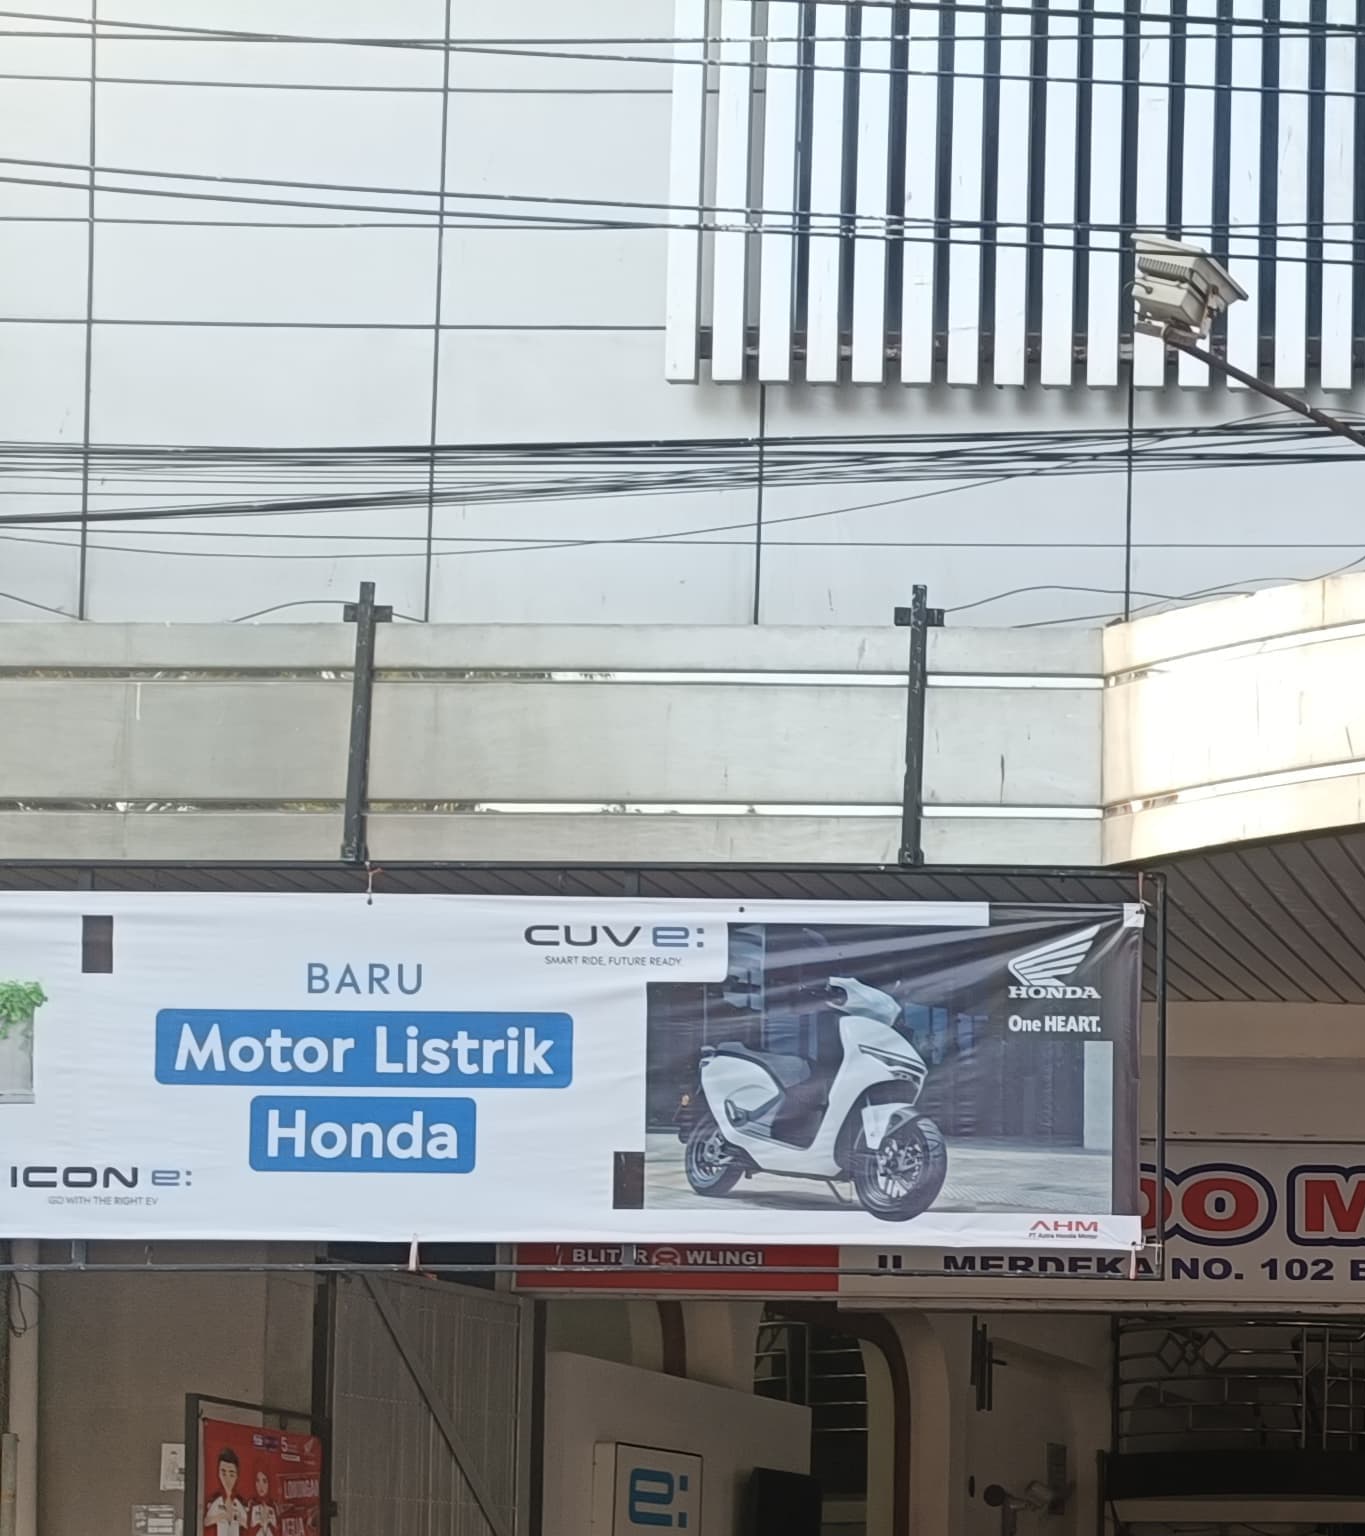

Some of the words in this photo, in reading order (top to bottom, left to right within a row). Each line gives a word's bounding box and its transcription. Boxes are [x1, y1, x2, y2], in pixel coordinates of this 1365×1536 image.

[524, 924, 642, 948] CUV
[652, 926, 705, 948] e:
[544, 955, 579, 966] SMART
[608, 956, 648, 967] FUTURE
[307, 962, 424, 995] BARU
[1007, 985, 1102, 1000] HONDA
[1007, 1014, 1042, 1033] One
[1044, 1015, 1102, 1033] HEART.
[174, 1022, 355, 1074] Motor
[375, 1024, 556, 1076] Listrik
[266, 1108, 459, 1160] Honda
[10, 1165, 139, 1189] ICON
[151, 1169, 193, 1187] e:
[66, 1195, 91, 1205] WITH
[93, 1195, 112, 1205] THE
[114, 1195, 143, 1206] RIGHT
[1030, 1220, 1099, 1232] AHM
[686, 1248, 763, 1266] WLINGI
[1170, 1257, 1244, 1281] NO.
[1260, 1257, 1335, 1282] 102
